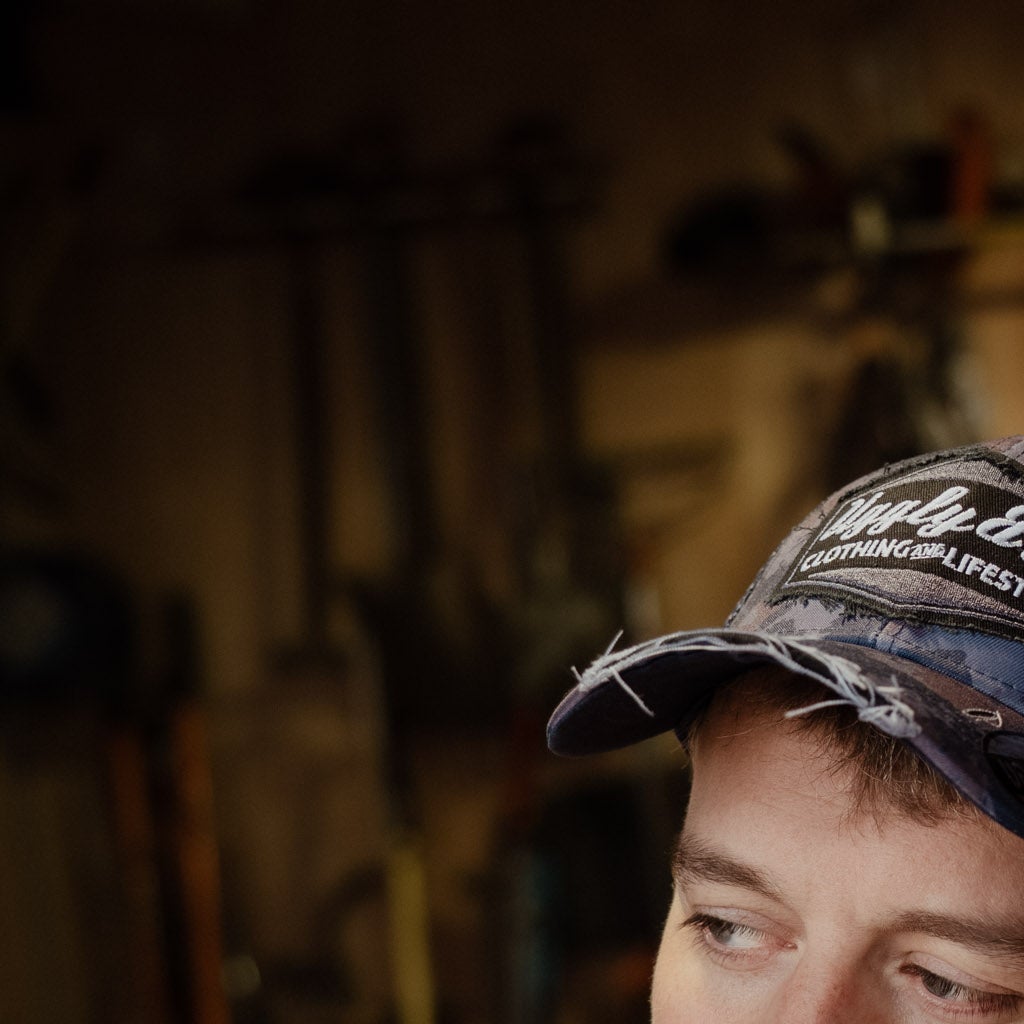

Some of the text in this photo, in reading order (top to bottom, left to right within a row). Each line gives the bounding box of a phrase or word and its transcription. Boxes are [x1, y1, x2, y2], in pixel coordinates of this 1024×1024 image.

[820, 485, 977, 540] Uggly
[800, 539, 914, 572] CLOTHING
[910, 543, 947, 560] AND
